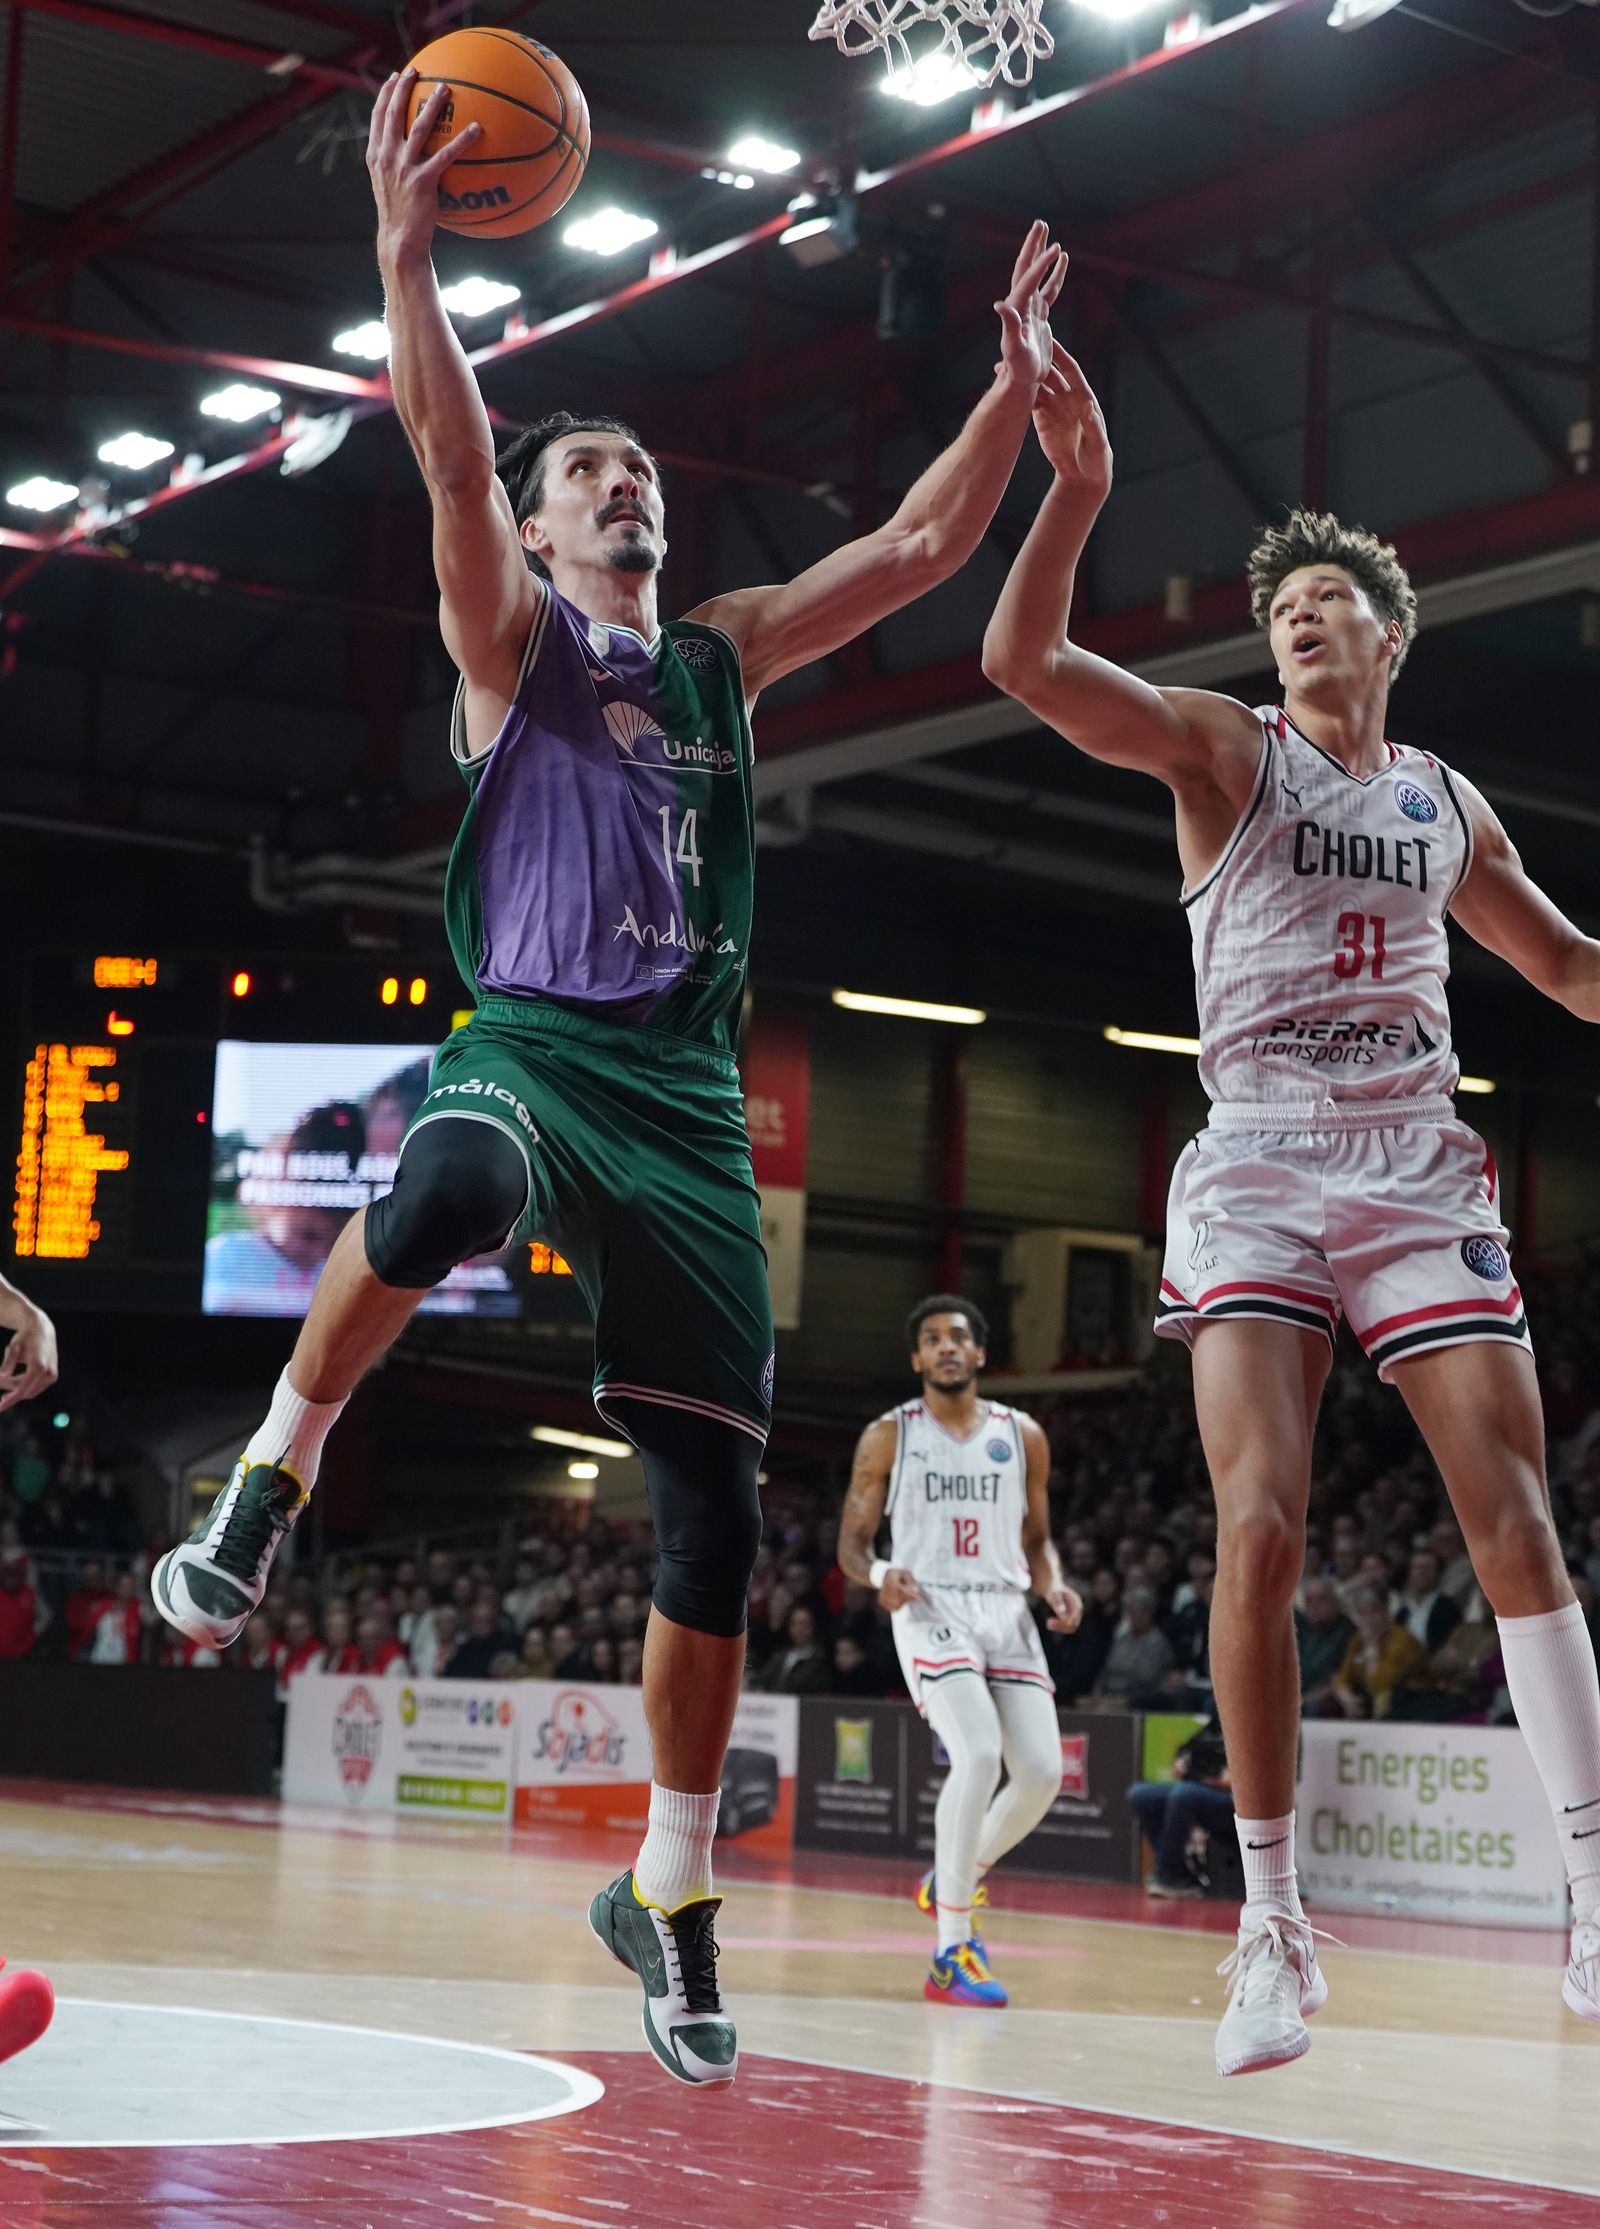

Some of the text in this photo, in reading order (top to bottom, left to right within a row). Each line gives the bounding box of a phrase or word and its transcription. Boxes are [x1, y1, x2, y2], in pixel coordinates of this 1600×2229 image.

[437, 185, 512, 211] son
[662, 736, 736, 771] Unicaja
[657, 805, 704, 887] 14
[1293, 820, 1431, 893] CHOLET
[612, 903, 739, 955] Andaluía
[1333, 912, 1386, 980] 31
[1251, 1037, 1377, 1067] Transports
[925, 1472, 1003, 1504] CHOLET
[953, 1517, 980, 1557] 12
[1336, 1738, 1490, 1804] Energies
[1311, 1807, 1516, 1869] Choletaises
